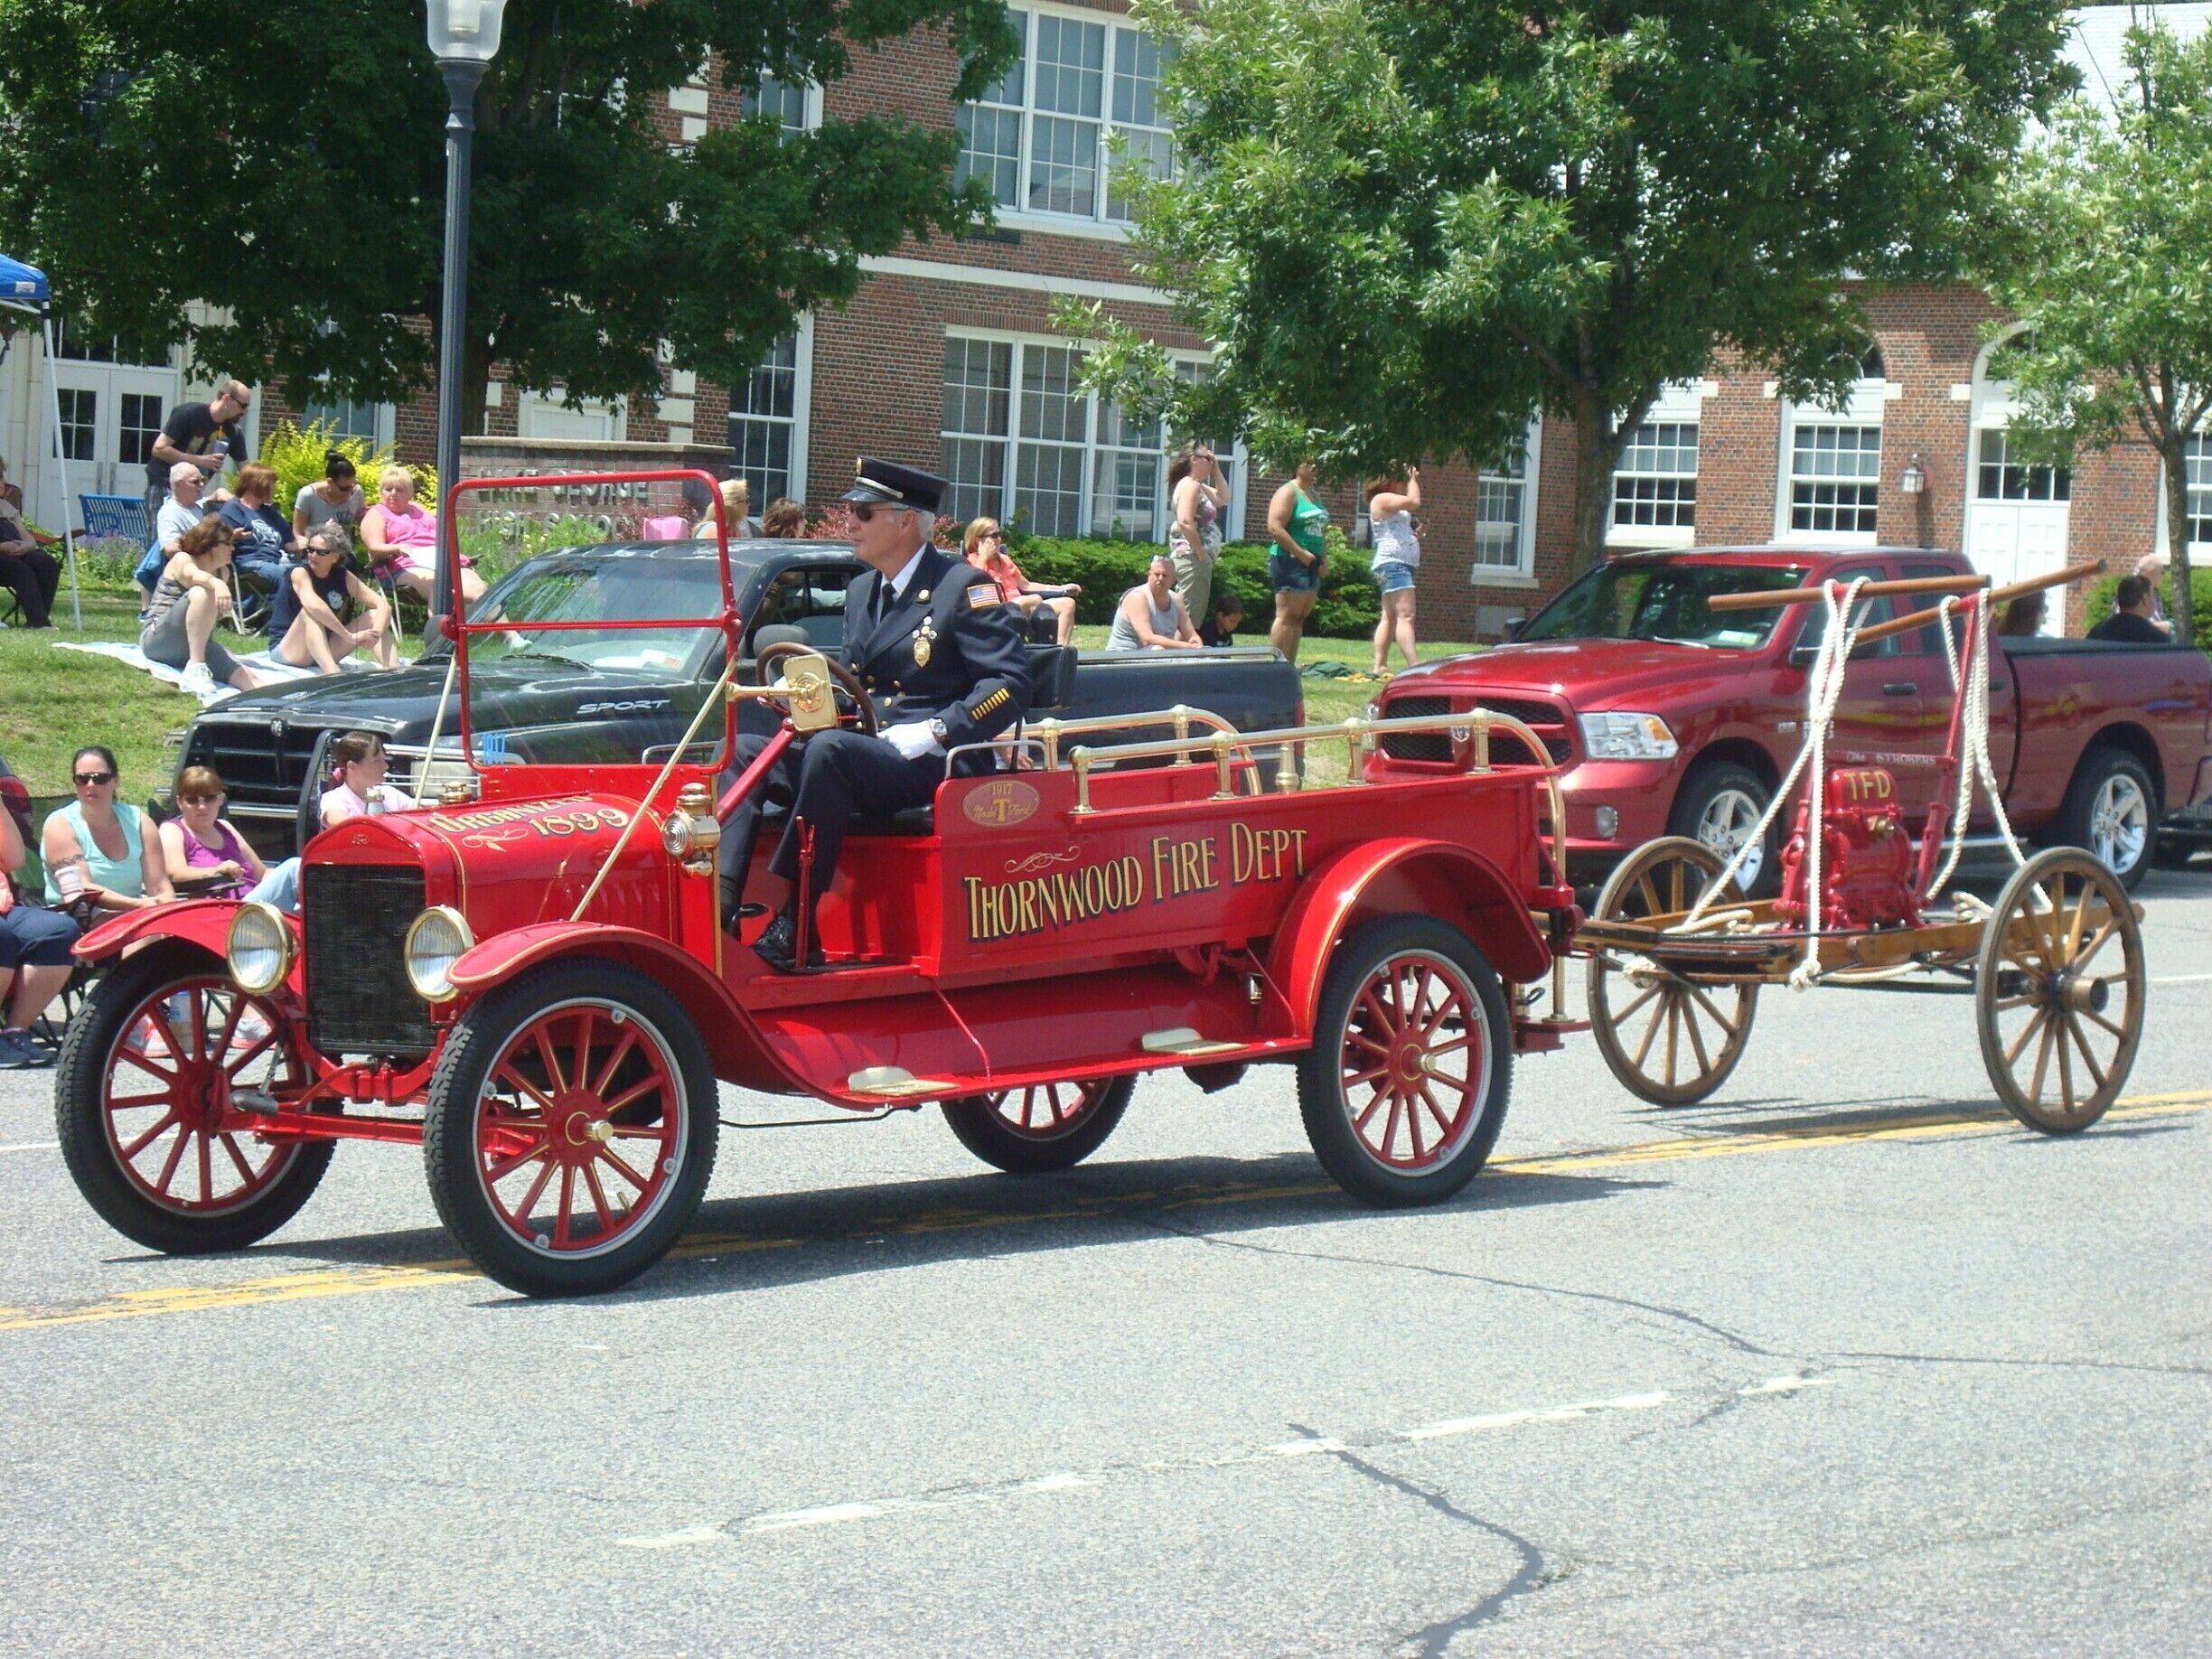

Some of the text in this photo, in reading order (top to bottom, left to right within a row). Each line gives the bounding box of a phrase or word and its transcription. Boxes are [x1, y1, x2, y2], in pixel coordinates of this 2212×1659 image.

[576, 699, 670, 715] SPORT
[1875, 752, 1936, 766] STROKERS
[991, 783, 1013, 796] 1917
[1843, 771, 1891, 800] TFD
[428, 795, 593, 833] ORGANIZED
[528, 808, 629, 837] 1899
[991, 797, 1012, 823] T
[963, 821, 1308, 941] THORNWOOD FIRE DEPT
